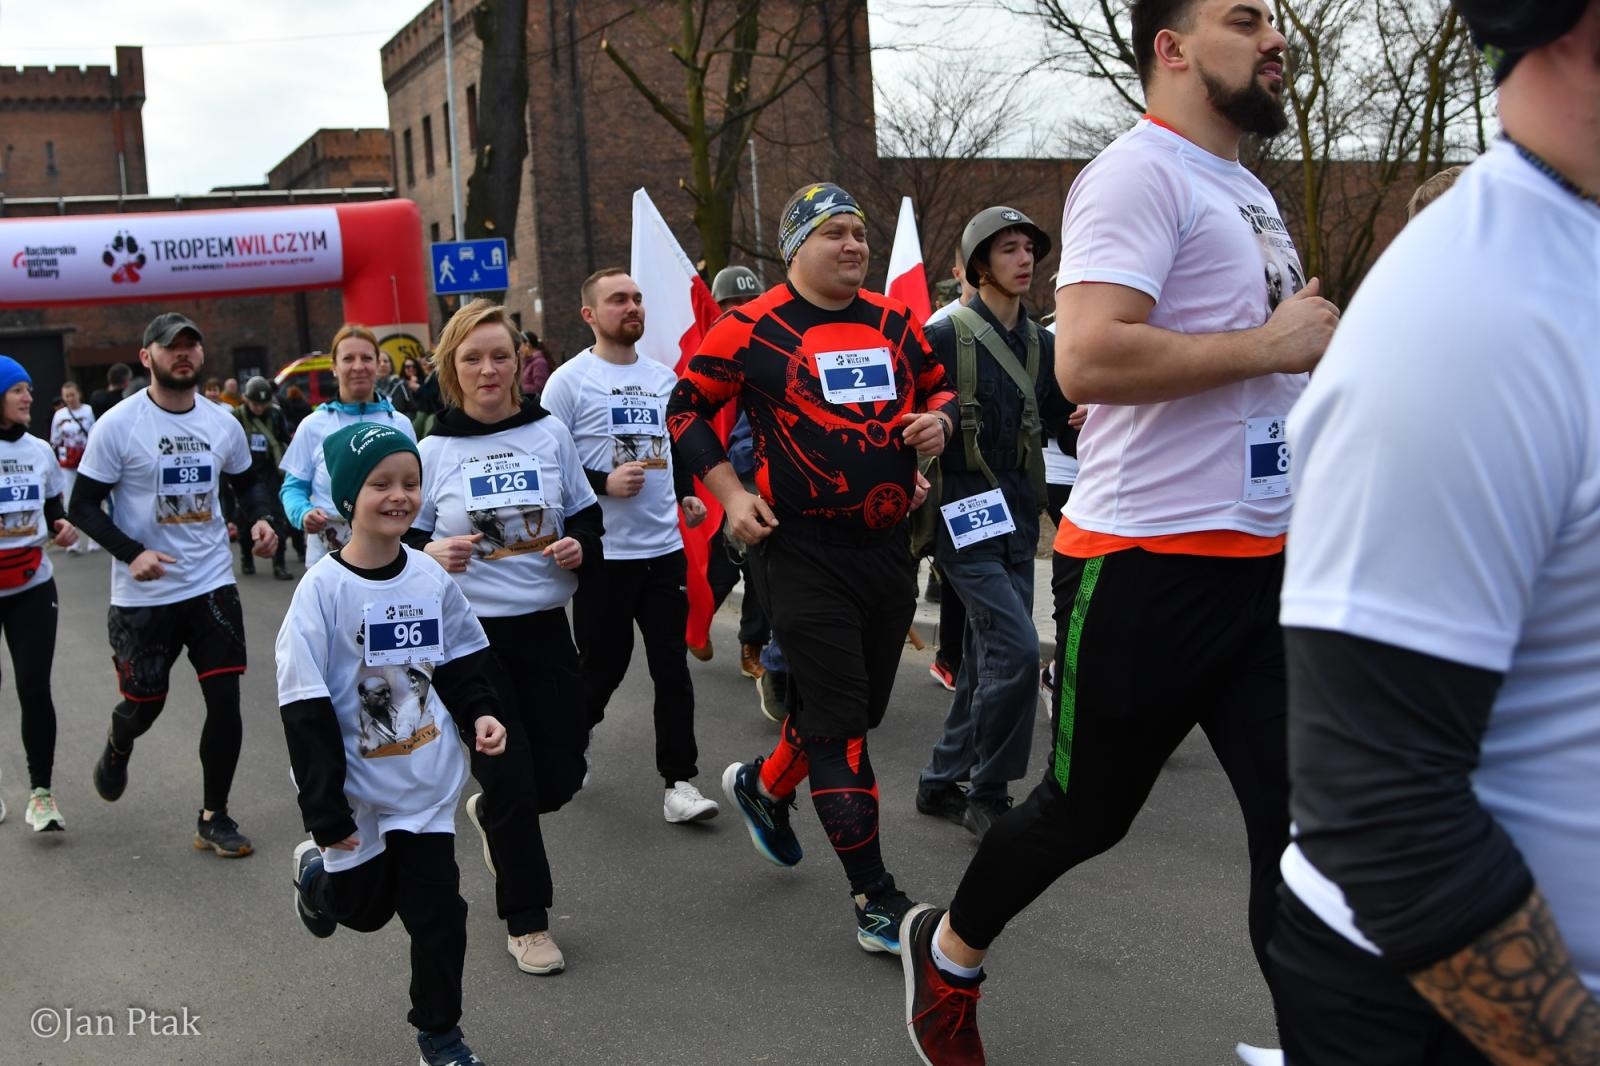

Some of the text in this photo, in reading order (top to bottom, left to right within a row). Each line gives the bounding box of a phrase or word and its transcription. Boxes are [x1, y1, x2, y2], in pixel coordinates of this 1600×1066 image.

[736, 276, 755, 290] OC
[851, 368, 867, 387] 2
[624, 409, 652, 423] 128
[486, 452, 514, 460] TROPEM
[179, 468, 199, 483] 98
[486, 472, 528, 493] 126
[11, 486, 29, 500] 97
[968, 509, 993, 529] 52
[394, 622, 423, 648] 96
